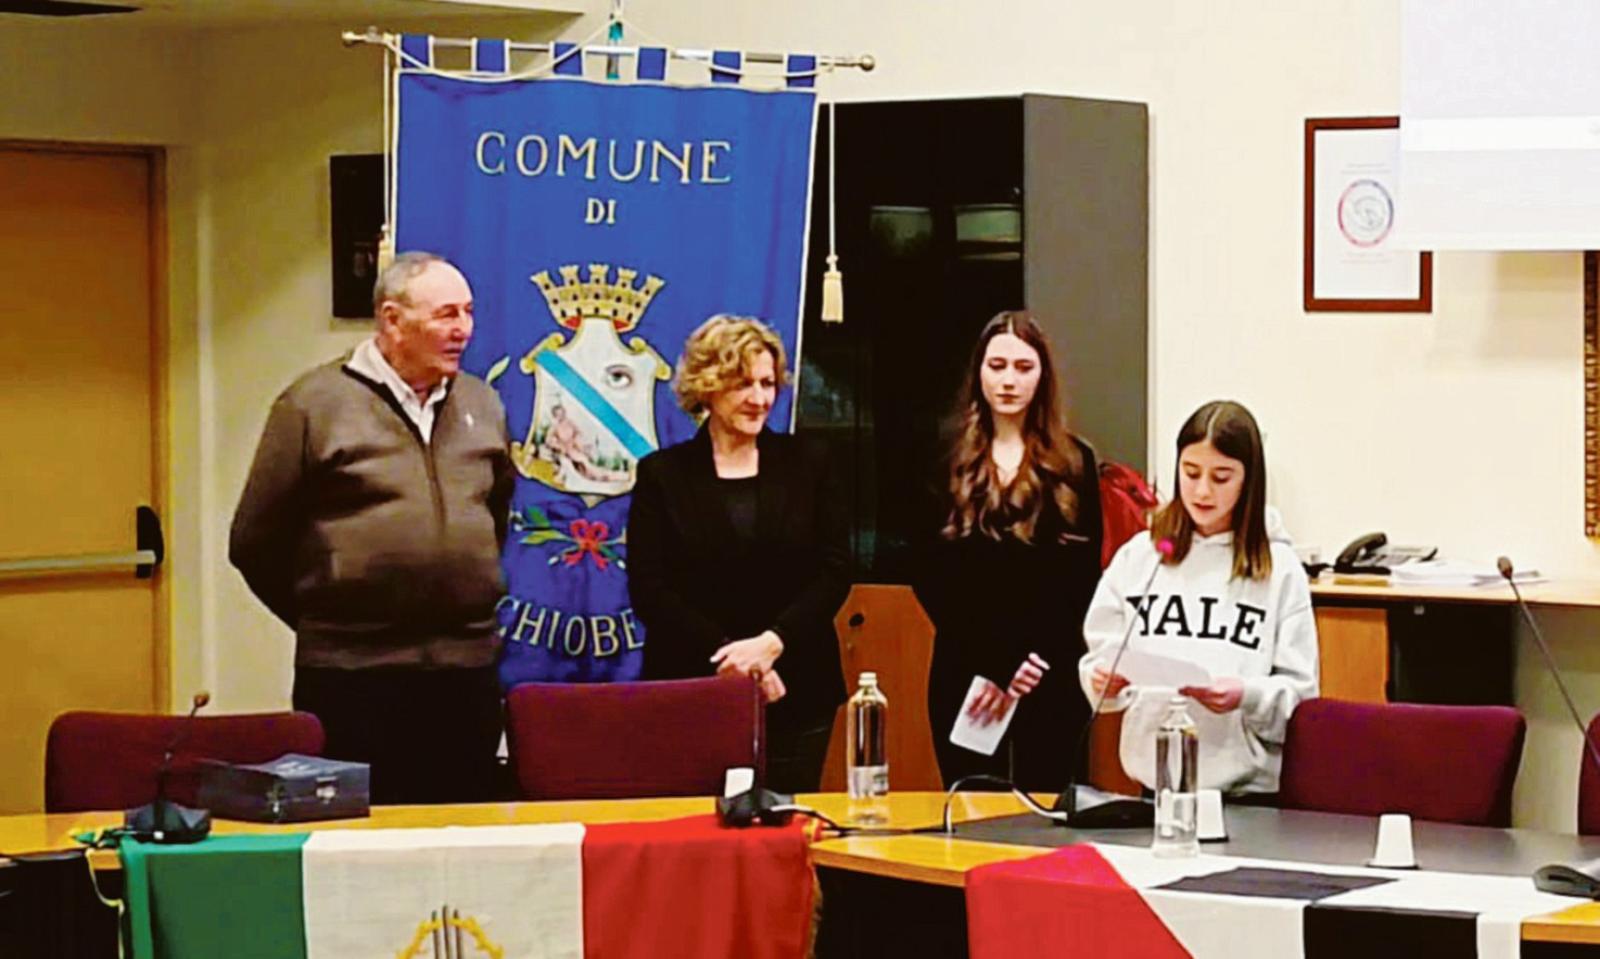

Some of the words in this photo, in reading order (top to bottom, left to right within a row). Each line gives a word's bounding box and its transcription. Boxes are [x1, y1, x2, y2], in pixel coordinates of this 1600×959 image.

[475, 131, 732, 184] COMUNE
[584, 197, 616, 224] DI
[1125, 594, 1266, 649] YALE
